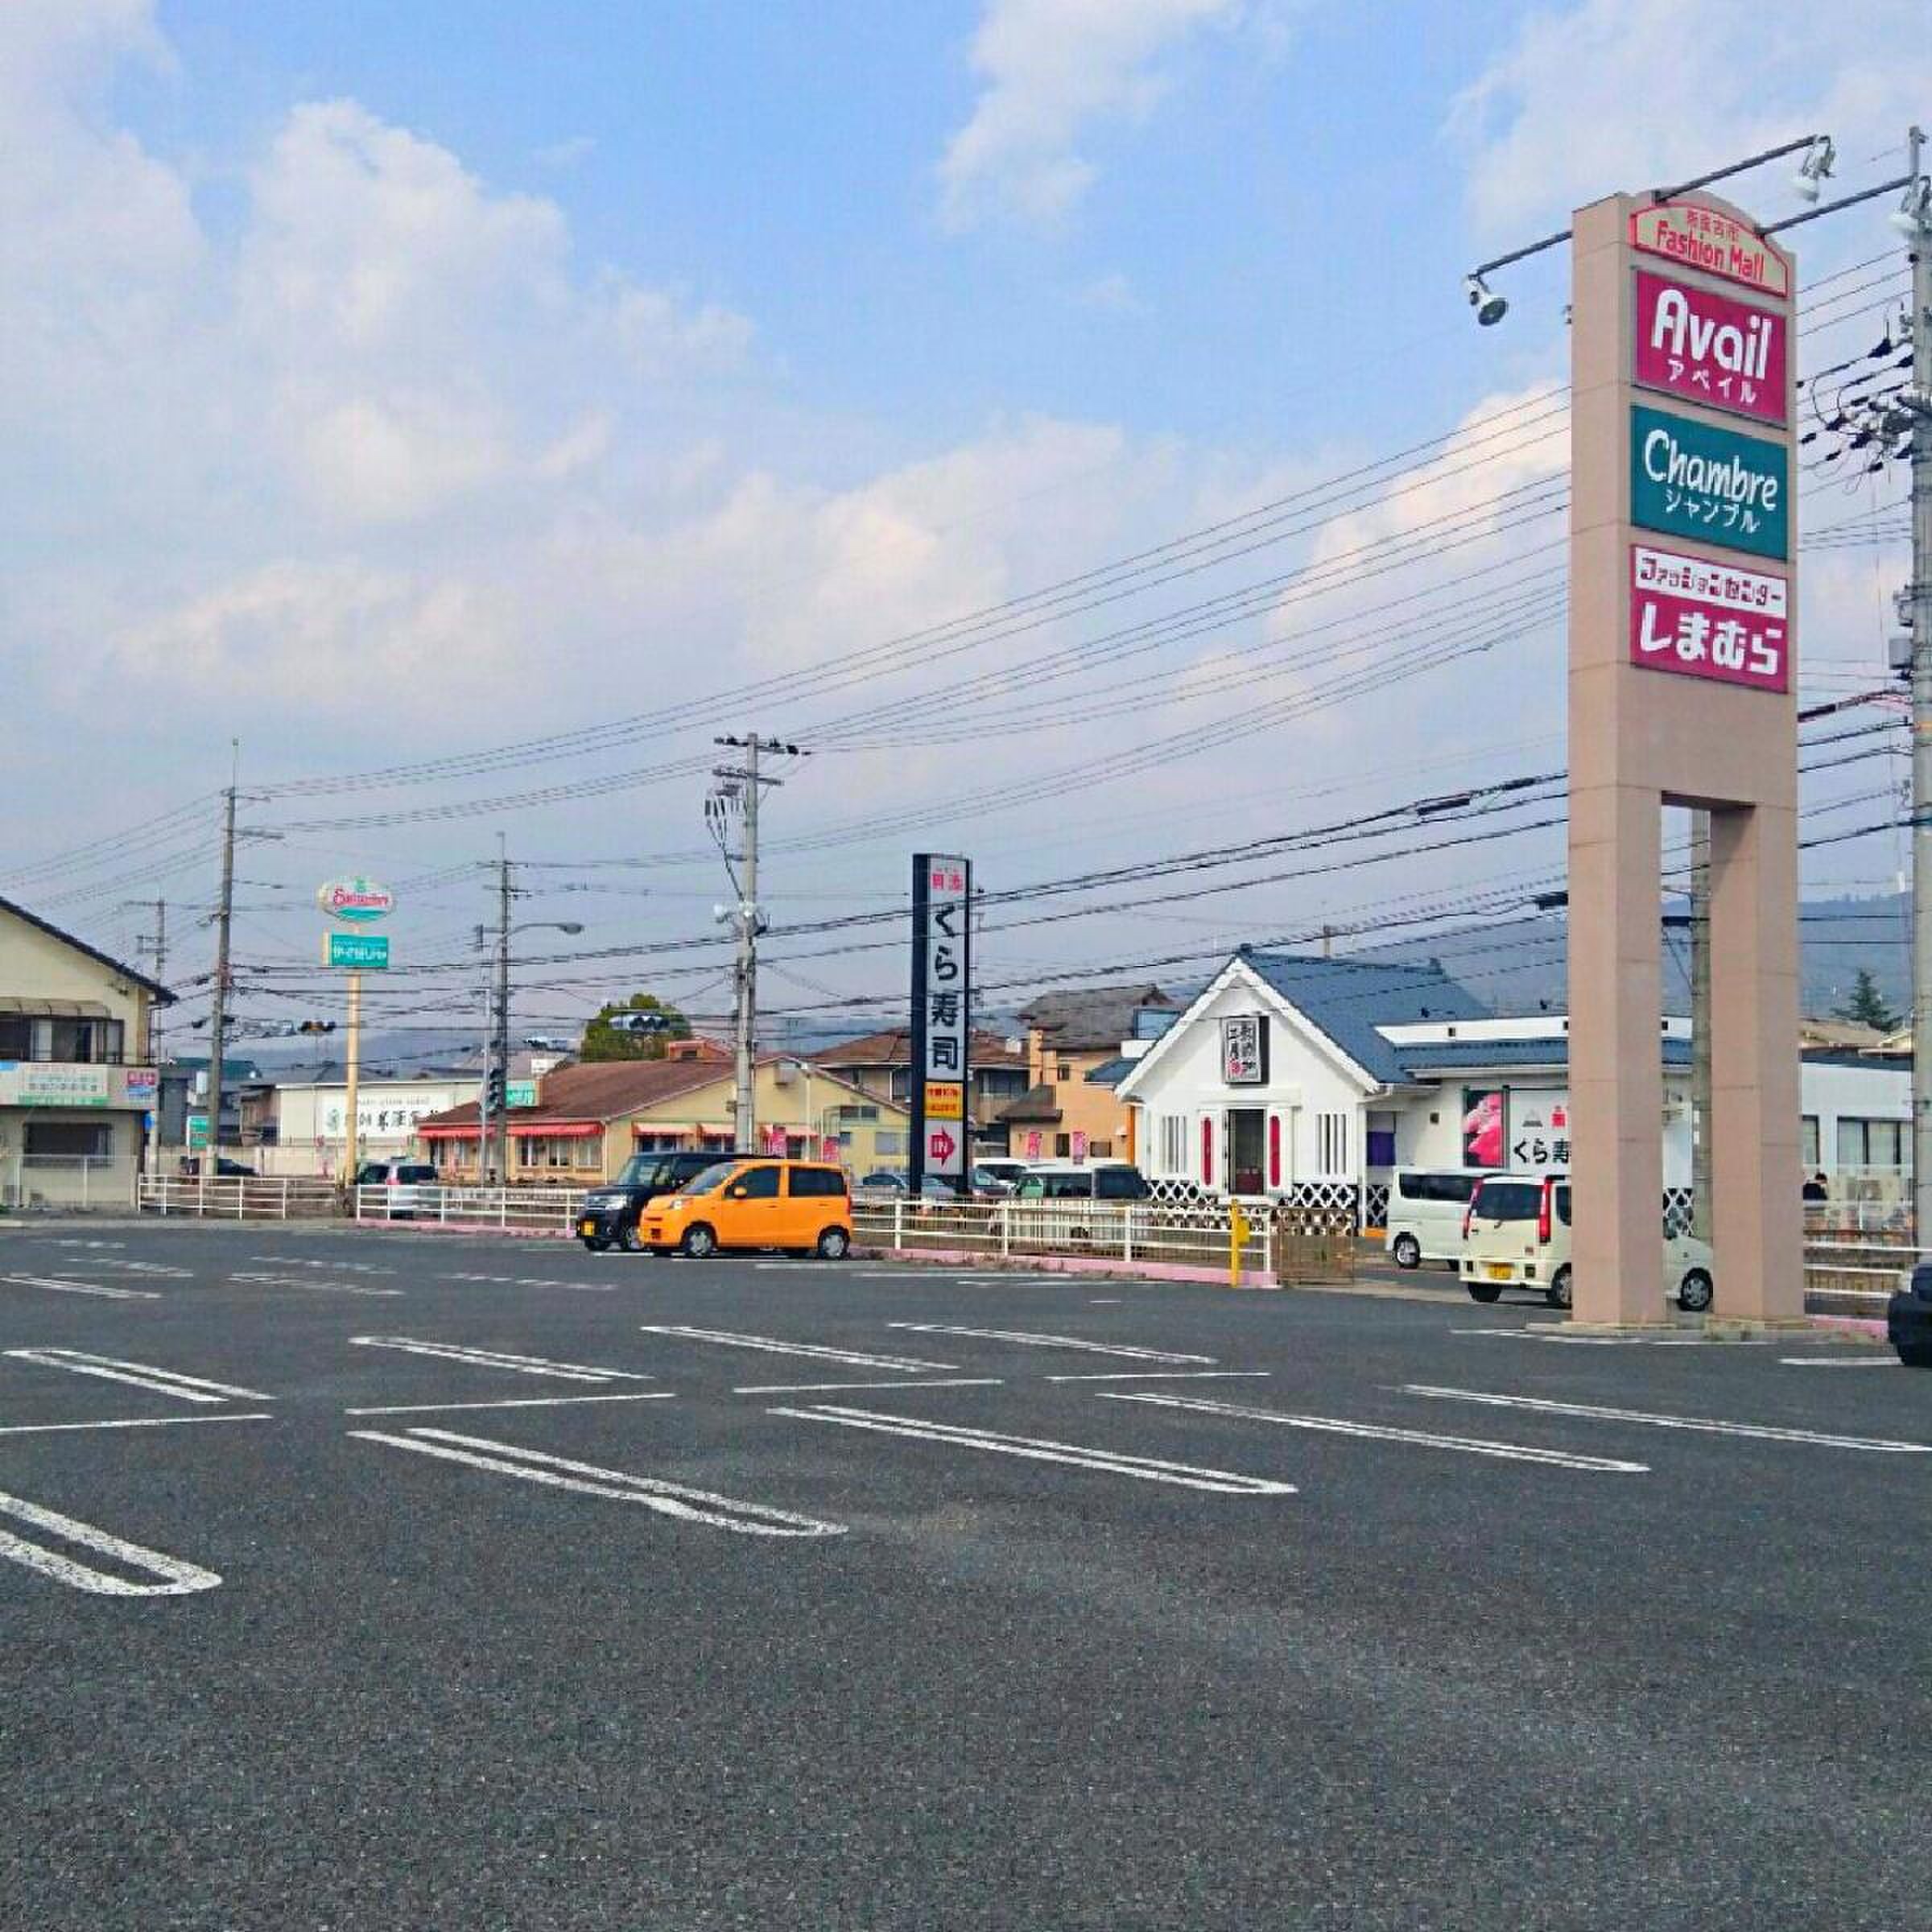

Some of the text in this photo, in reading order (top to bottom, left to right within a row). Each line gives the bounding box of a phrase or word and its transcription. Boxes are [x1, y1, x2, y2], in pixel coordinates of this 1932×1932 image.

[1657, 220, 1765, 279] Fashion Mall
[1650, 288, 1772, 380] Avail
[1645, 429, 1778, 511] Chambre
[1666, 489, 1761, 533] シャンブル
[1640, 602, 1782, 675] しまむら
[931, 904, 959, 1070] くら寿司
